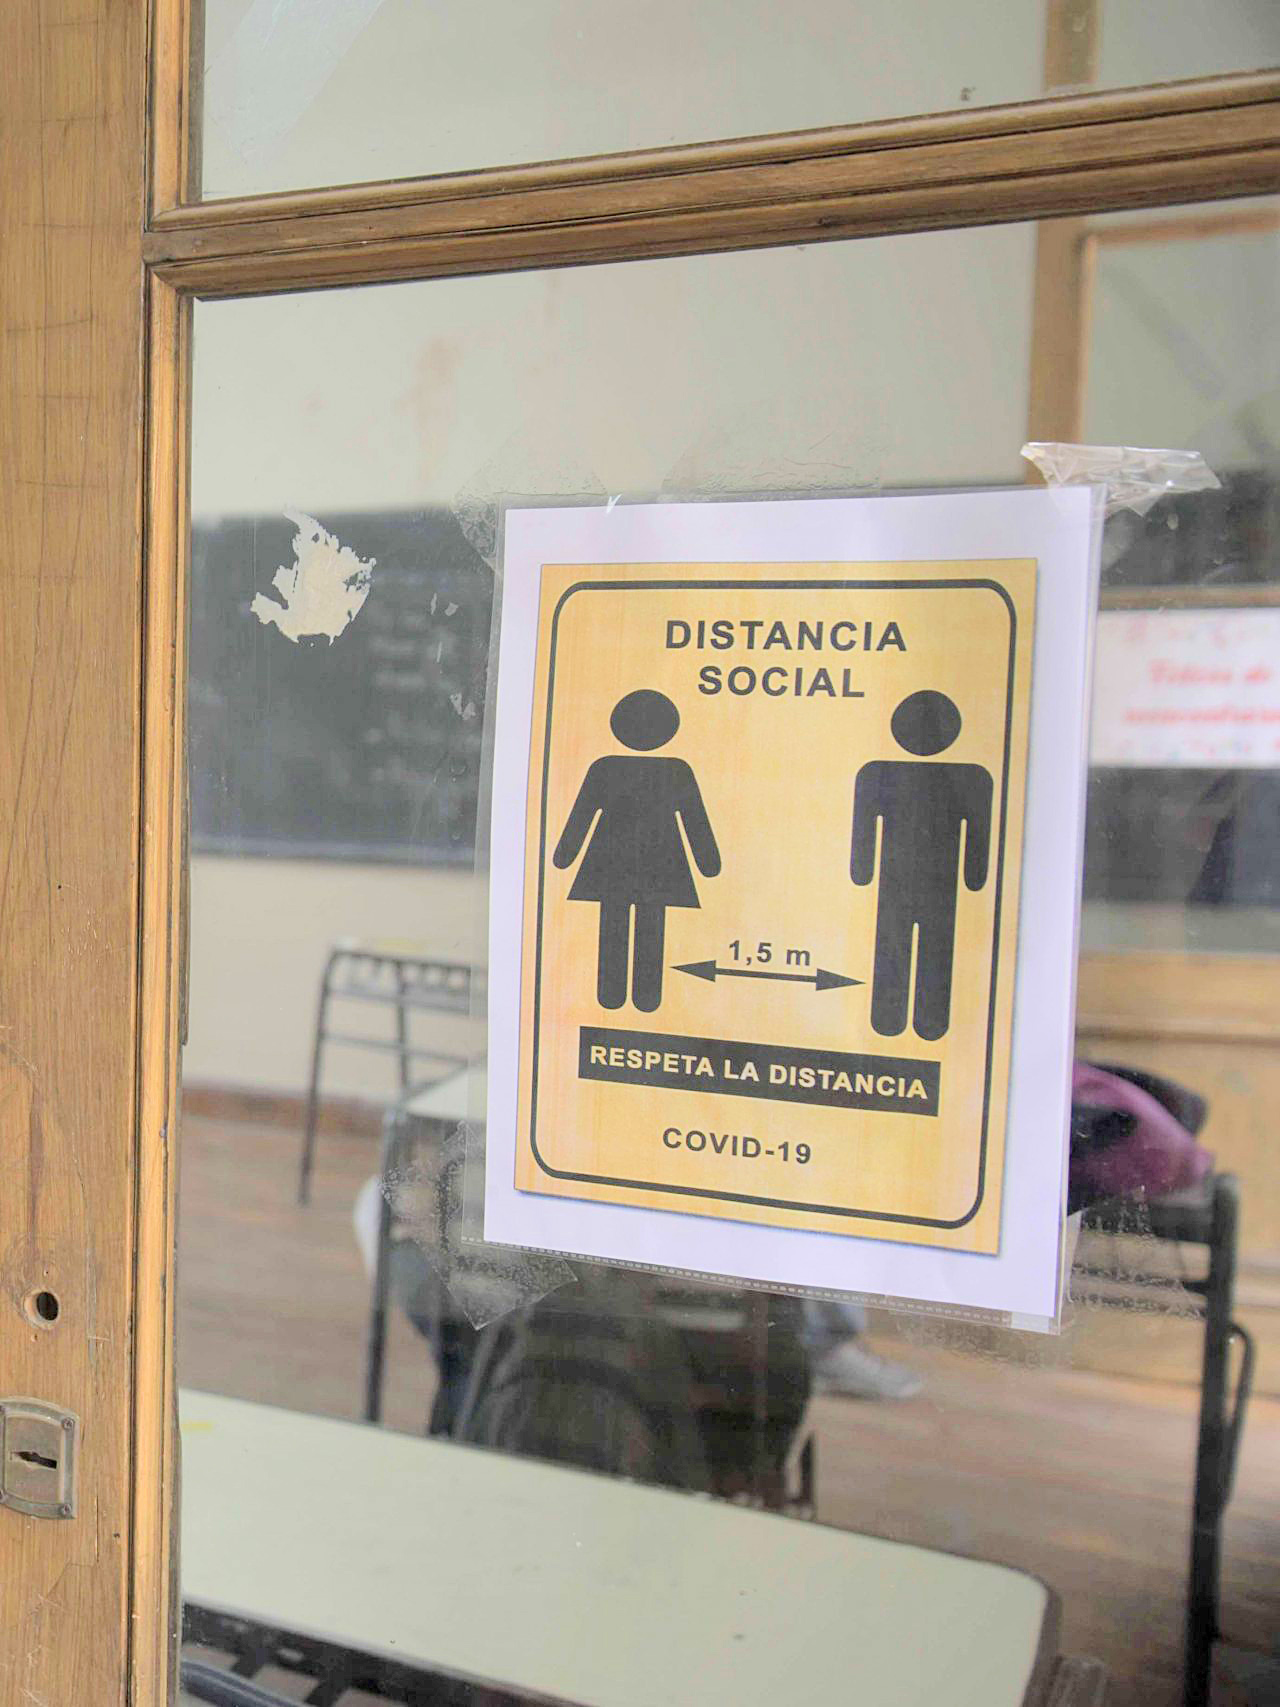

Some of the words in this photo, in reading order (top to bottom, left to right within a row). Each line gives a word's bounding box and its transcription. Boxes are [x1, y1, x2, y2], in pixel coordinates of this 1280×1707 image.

[665, 620, 907, 652] DISTANCIA
[698, 665, 865, 698] SOCIAL
[728, 940, 772, 965] 1,5
[785, 948, 811, 967] m
[589, 1045, 715, 1077] RESPETA
[723, 1059, 760, 1082] LA
[768, 1063, 929, 1100] DISTANCIA
[662, 1127, 812, 1165] COVID-19
